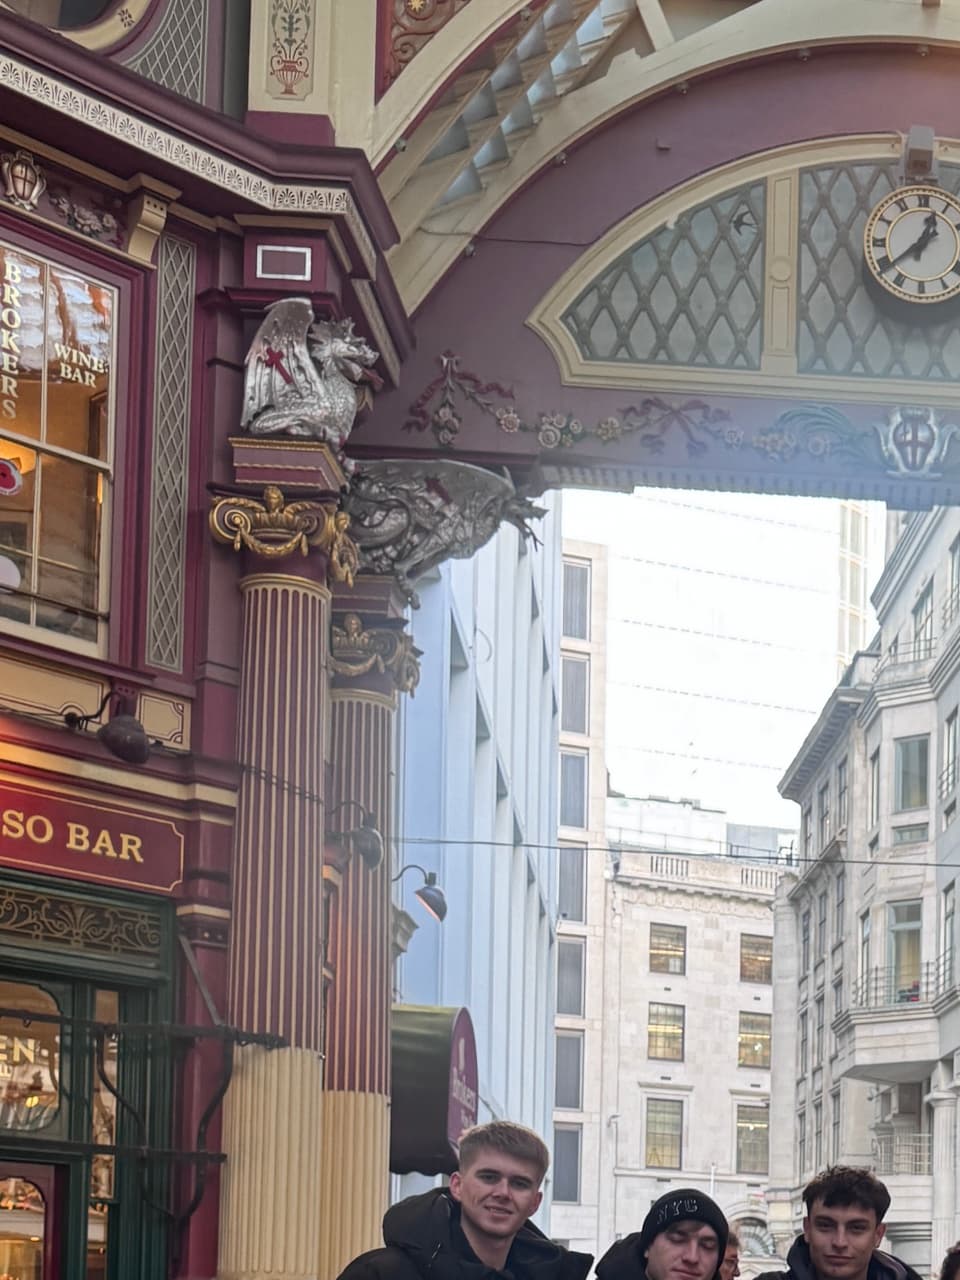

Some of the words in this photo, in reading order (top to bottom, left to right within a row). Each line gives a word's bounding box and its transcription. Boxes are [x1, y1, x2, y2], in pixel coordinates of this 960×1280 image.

[1, 261, 21, 419] BROKERS
[55, 342, 104, 373] WINE
[60, 362, 96, 388] BAR
[2, 809, 54, 844] SO
[66, 822, 144, 863] BAR
